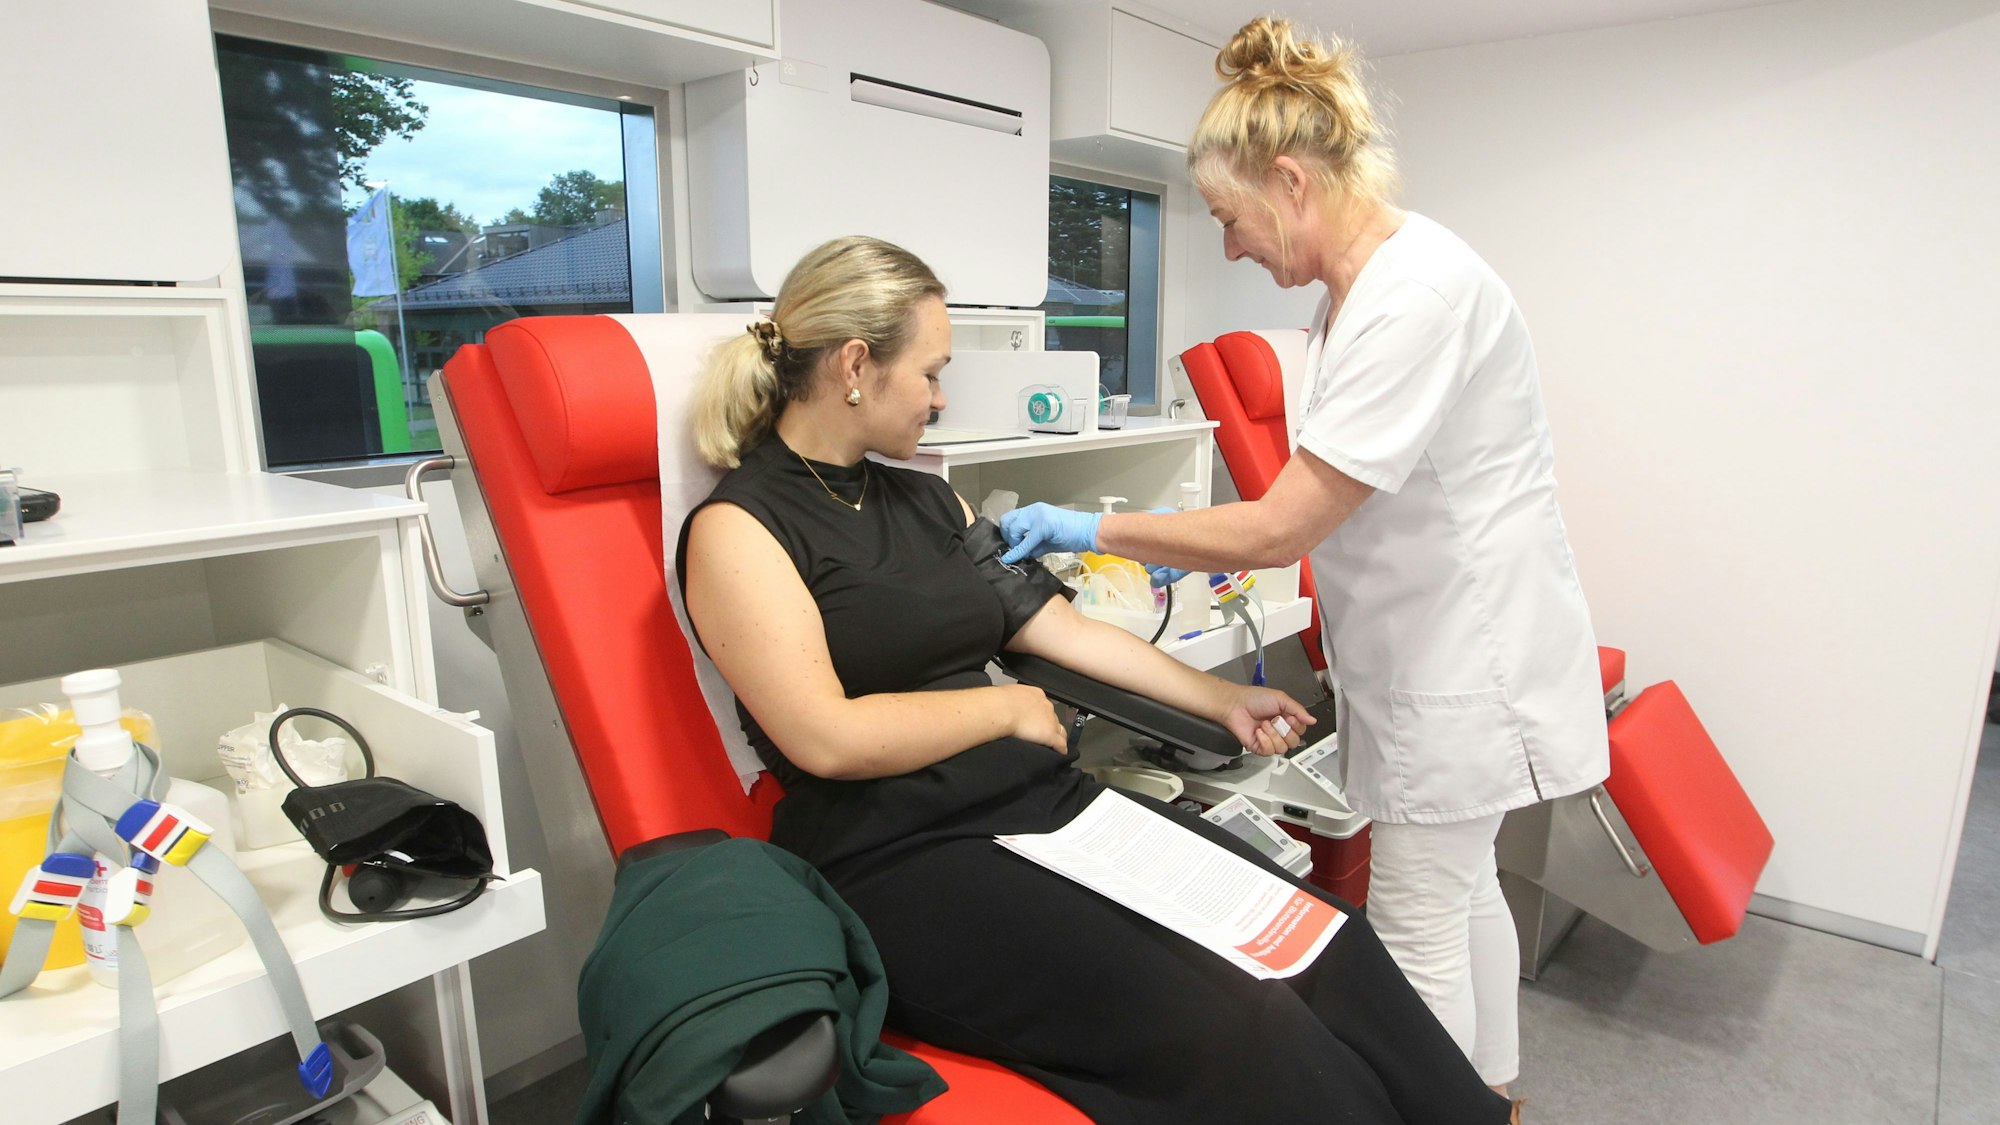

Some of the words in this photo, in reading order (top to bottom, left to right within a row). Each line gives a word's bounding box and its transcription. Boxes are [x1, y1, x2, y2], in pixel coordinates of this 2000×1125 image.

[1293, 896, 1305, 907] für
[1283, 901, 1314, 937] Information
[1272, 935, 1286, 947] und
